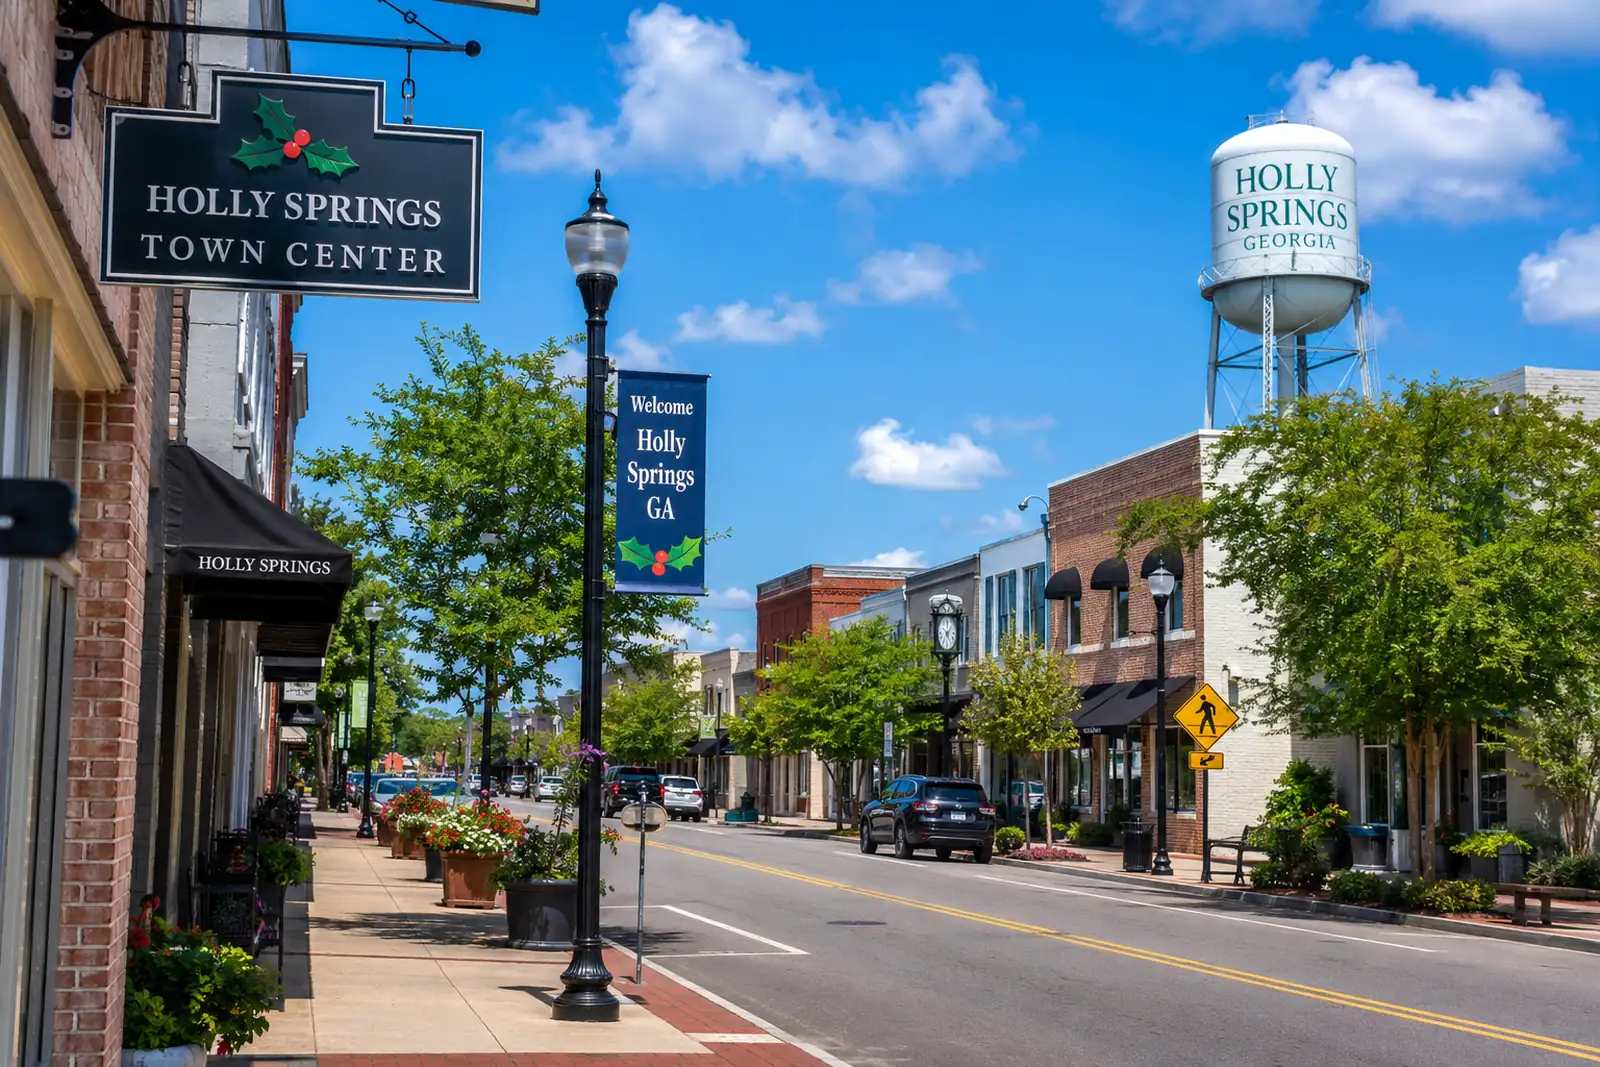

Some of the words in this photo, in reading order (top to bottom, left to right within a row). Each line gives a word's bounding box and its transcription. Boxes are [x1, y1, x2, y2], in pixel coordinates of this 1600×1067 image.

[1236, 163, 1338, 195] HOLLY
[147, 184, 275, 219] HOLLY
[284, 192, 442, 228] SPRINGS
[1227, 199, 1348, 232] SPRINGS
[141, 233, 266, 265] TOWN
[286, 242, 446, 274] CENTER
[1243, 233, 1336, 250] GEORGIA
[630, 395, 694, 416] Welcome
[637, 428, 686, 459] Holly
[627, 461, 695, 492] Springs
[646, 496, 675, 520] GA
[198, 555, 256, 572] HOLLY
[259, 558, 331, 575] SPRINGS
